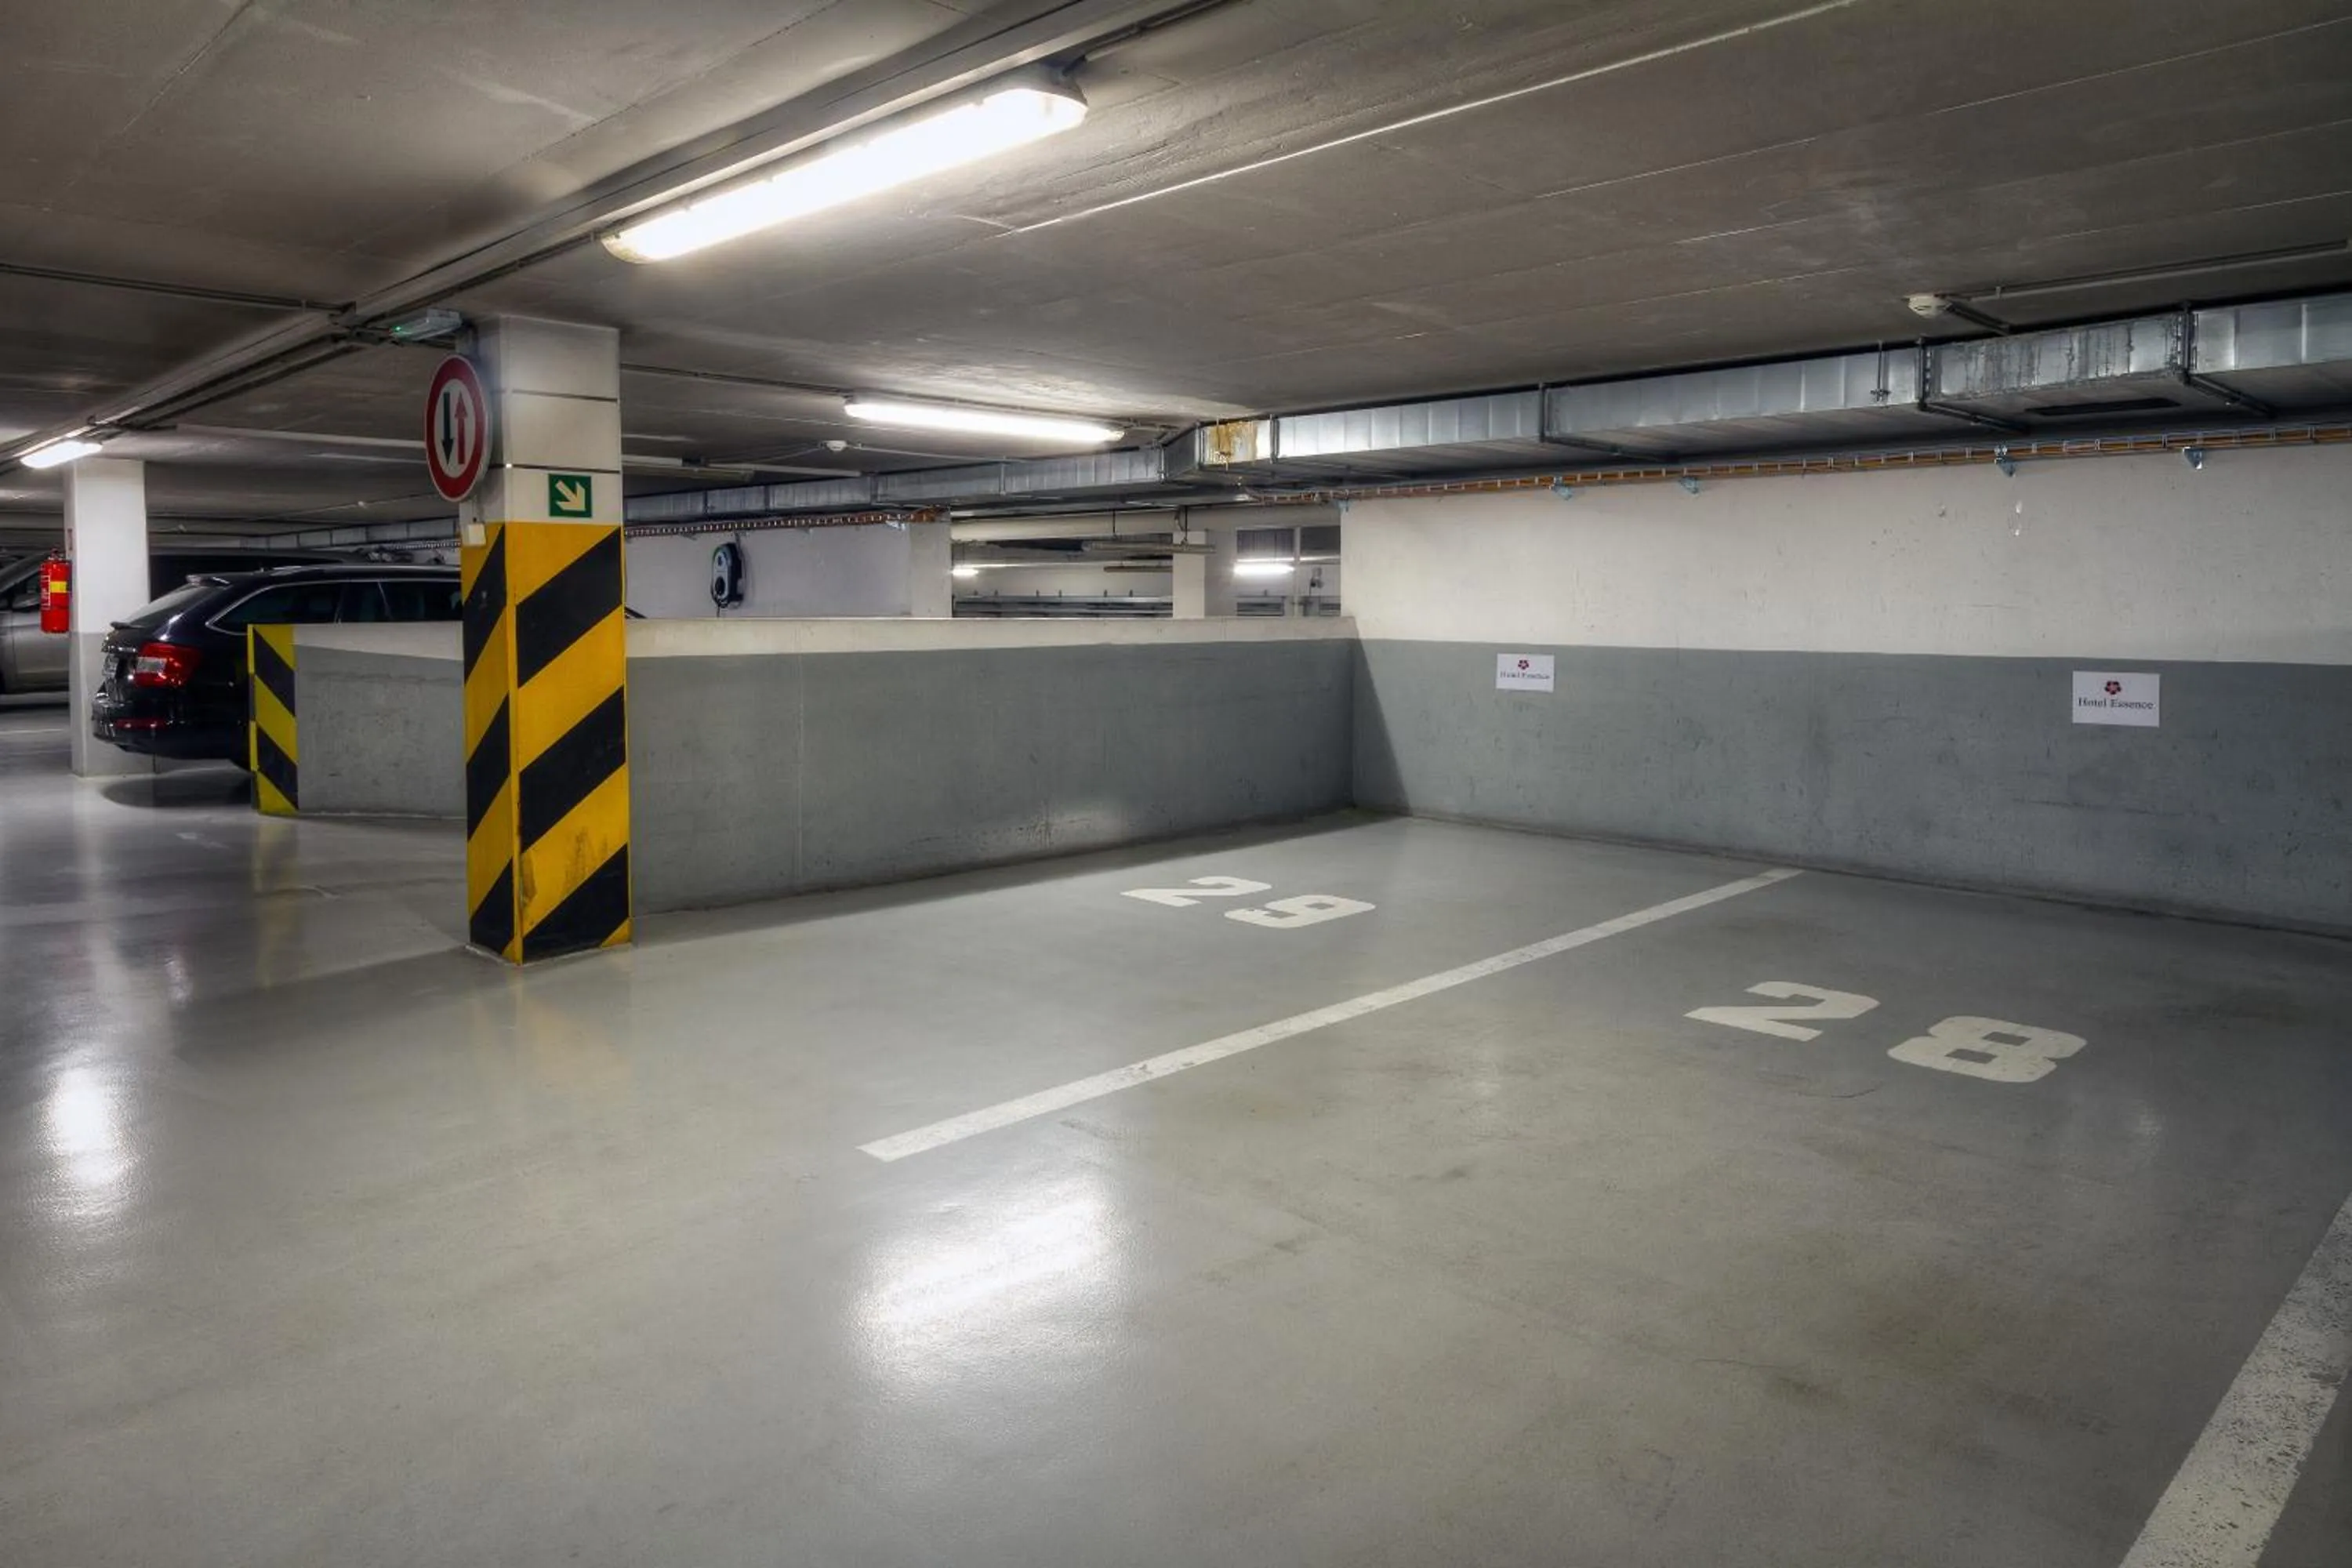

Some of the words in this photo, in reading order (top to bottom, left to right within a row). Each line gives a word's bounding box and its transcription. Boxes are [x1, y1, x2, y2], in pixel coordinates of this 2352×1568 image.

[2078, 697, 2107, 707] Hotel
[1120, 876, 1375, 928] 29
[1683, 981, 2087, 1083] 28
